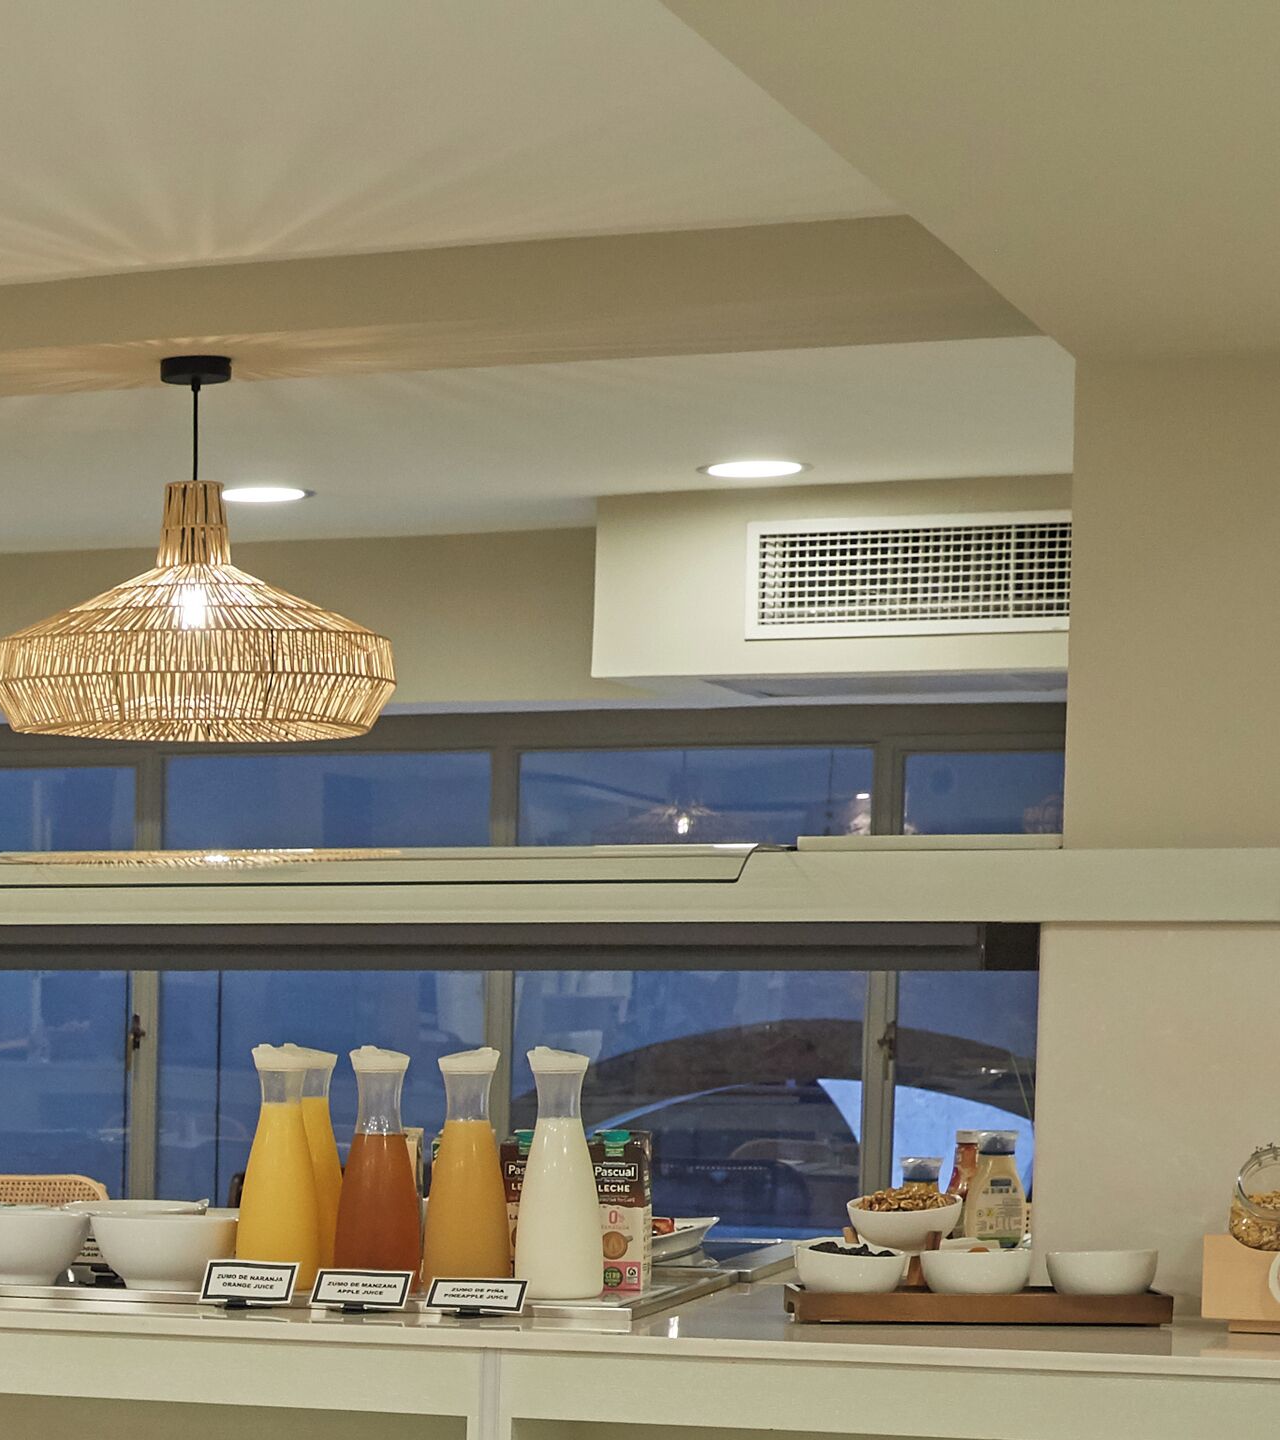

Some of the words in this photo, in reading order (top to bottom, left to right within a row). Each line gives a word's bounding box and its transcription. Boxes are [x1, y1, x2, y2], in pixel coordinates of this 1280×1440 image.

[594, 1166, 636, 1177] Pascual
[598, 1184, 630, 1193] LECHE
[222, 1281, 252, 1289] ORANGE
